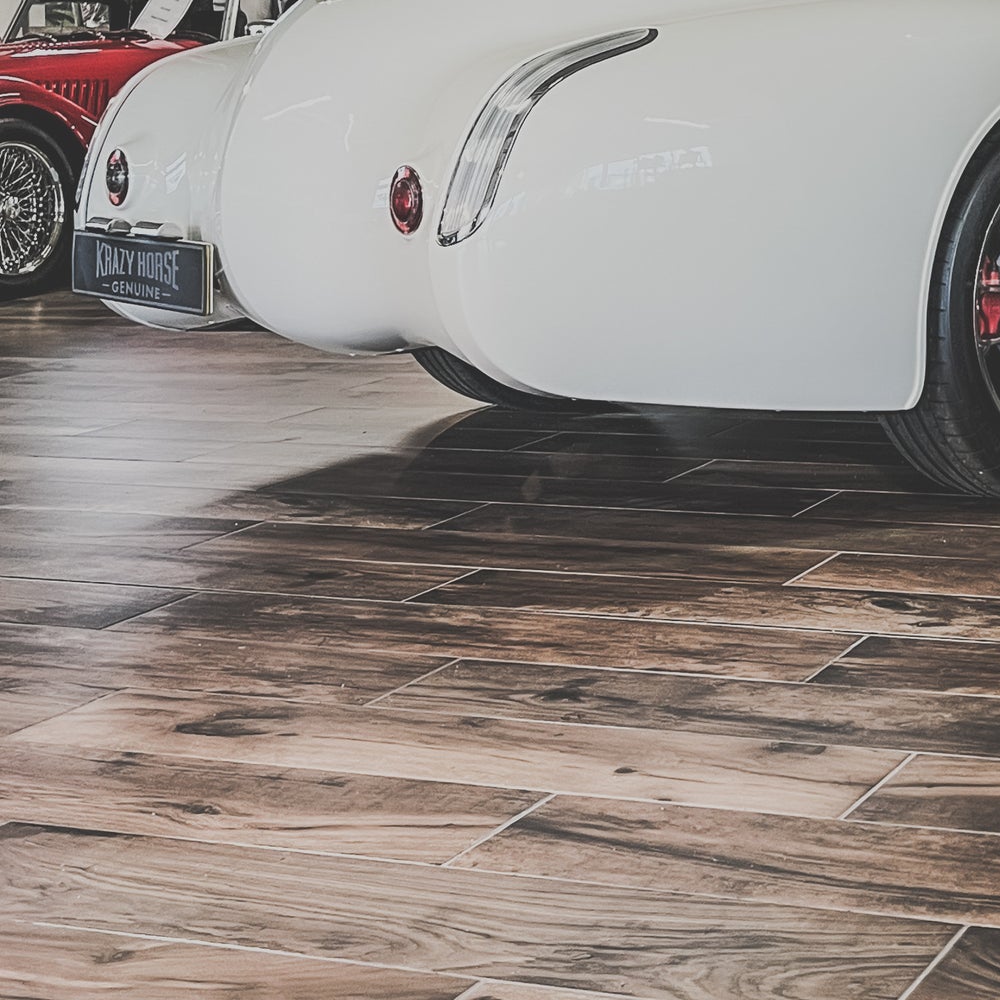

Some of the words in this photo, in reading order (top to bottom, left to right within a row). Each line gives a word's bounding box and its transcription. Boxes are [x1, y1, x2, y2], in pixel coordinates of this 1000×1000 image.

[96, 240, 135, 278] KRAZY
[137, 250, 179, 291] HORSE
[111, 281, 161, 300] GENUINE
